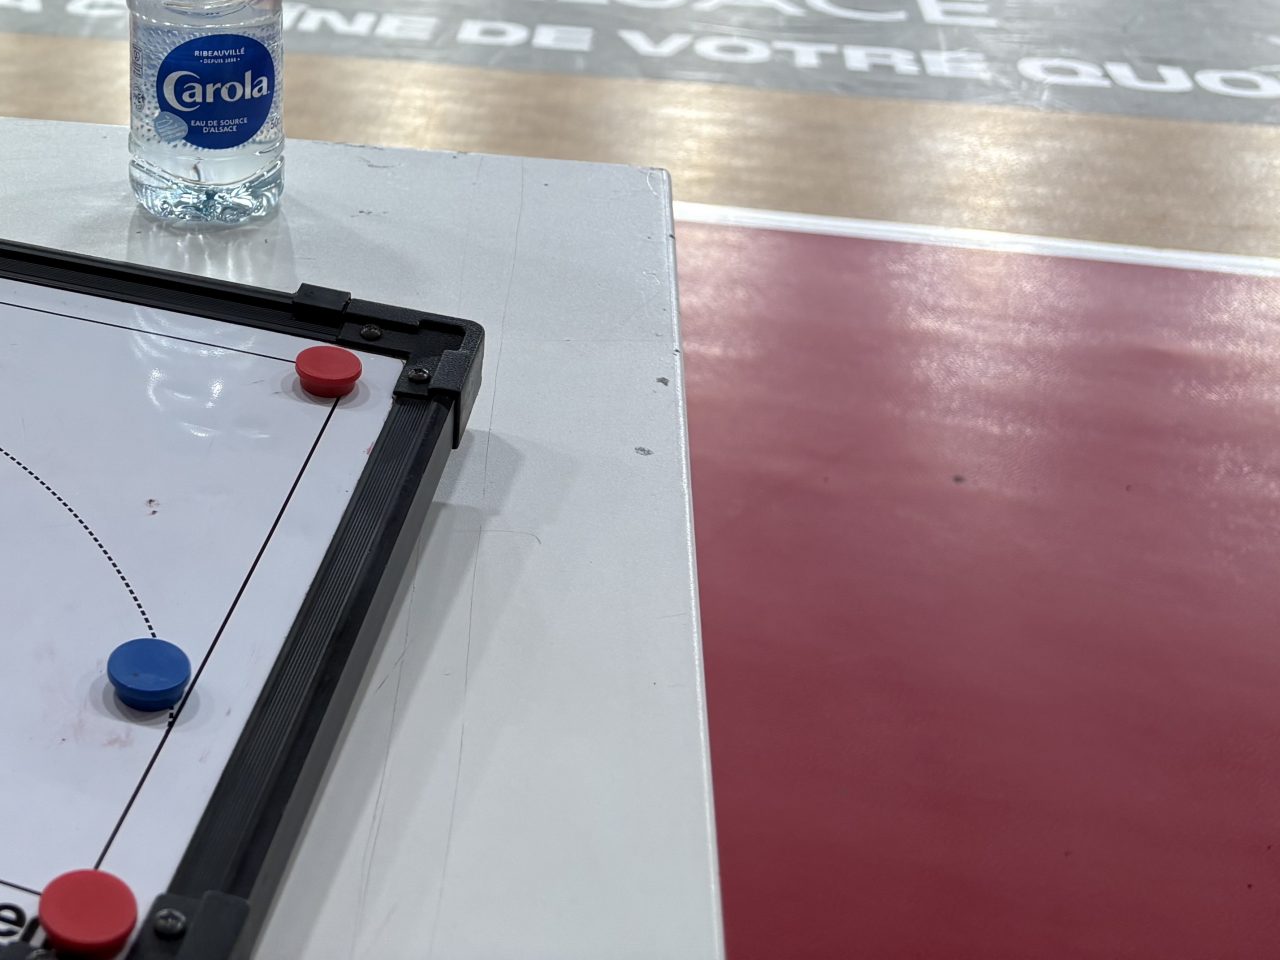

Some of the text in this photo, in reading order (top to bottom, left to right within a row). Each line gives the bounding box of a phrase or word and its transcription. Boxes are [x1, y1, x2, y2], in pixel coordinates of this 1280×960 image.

[194, 46, 245, 57] RIBEAUVILLÉ
[456, 19, 594, 52] DE
[619, 29, 990, 81] VOTRE
[163, 69, 270, 112] Carola
[191, 117, 248, 127] EAU DE SOURCE
[203, 126, 237, 134] D'ALSACE
